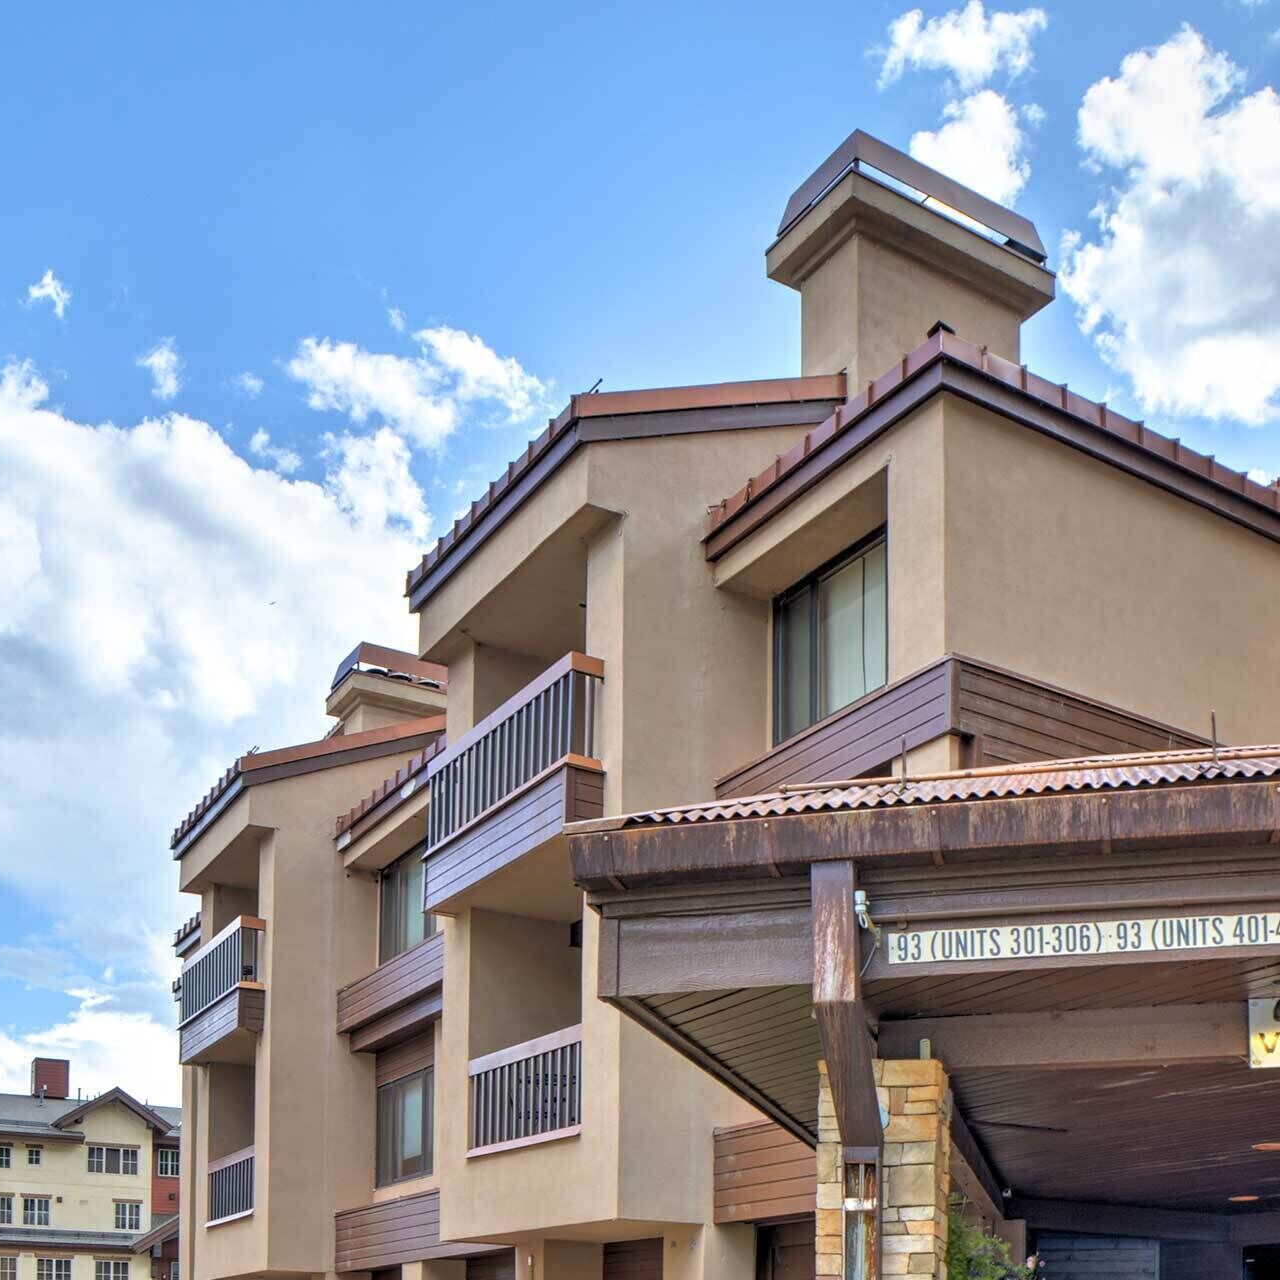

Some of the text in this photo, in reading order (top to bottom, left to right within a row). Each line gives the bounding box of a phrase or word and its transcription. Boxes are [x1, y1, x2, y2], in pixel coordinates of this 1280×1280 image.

[897, 934, 922, 961] 93
[930, 929, 1001, 960] (UNITS
[1010, 922, 1102, 955] 301-306)
[1117, 922, 1143, 950] 93
[1152, 917, 1224, 949] (UNITS
